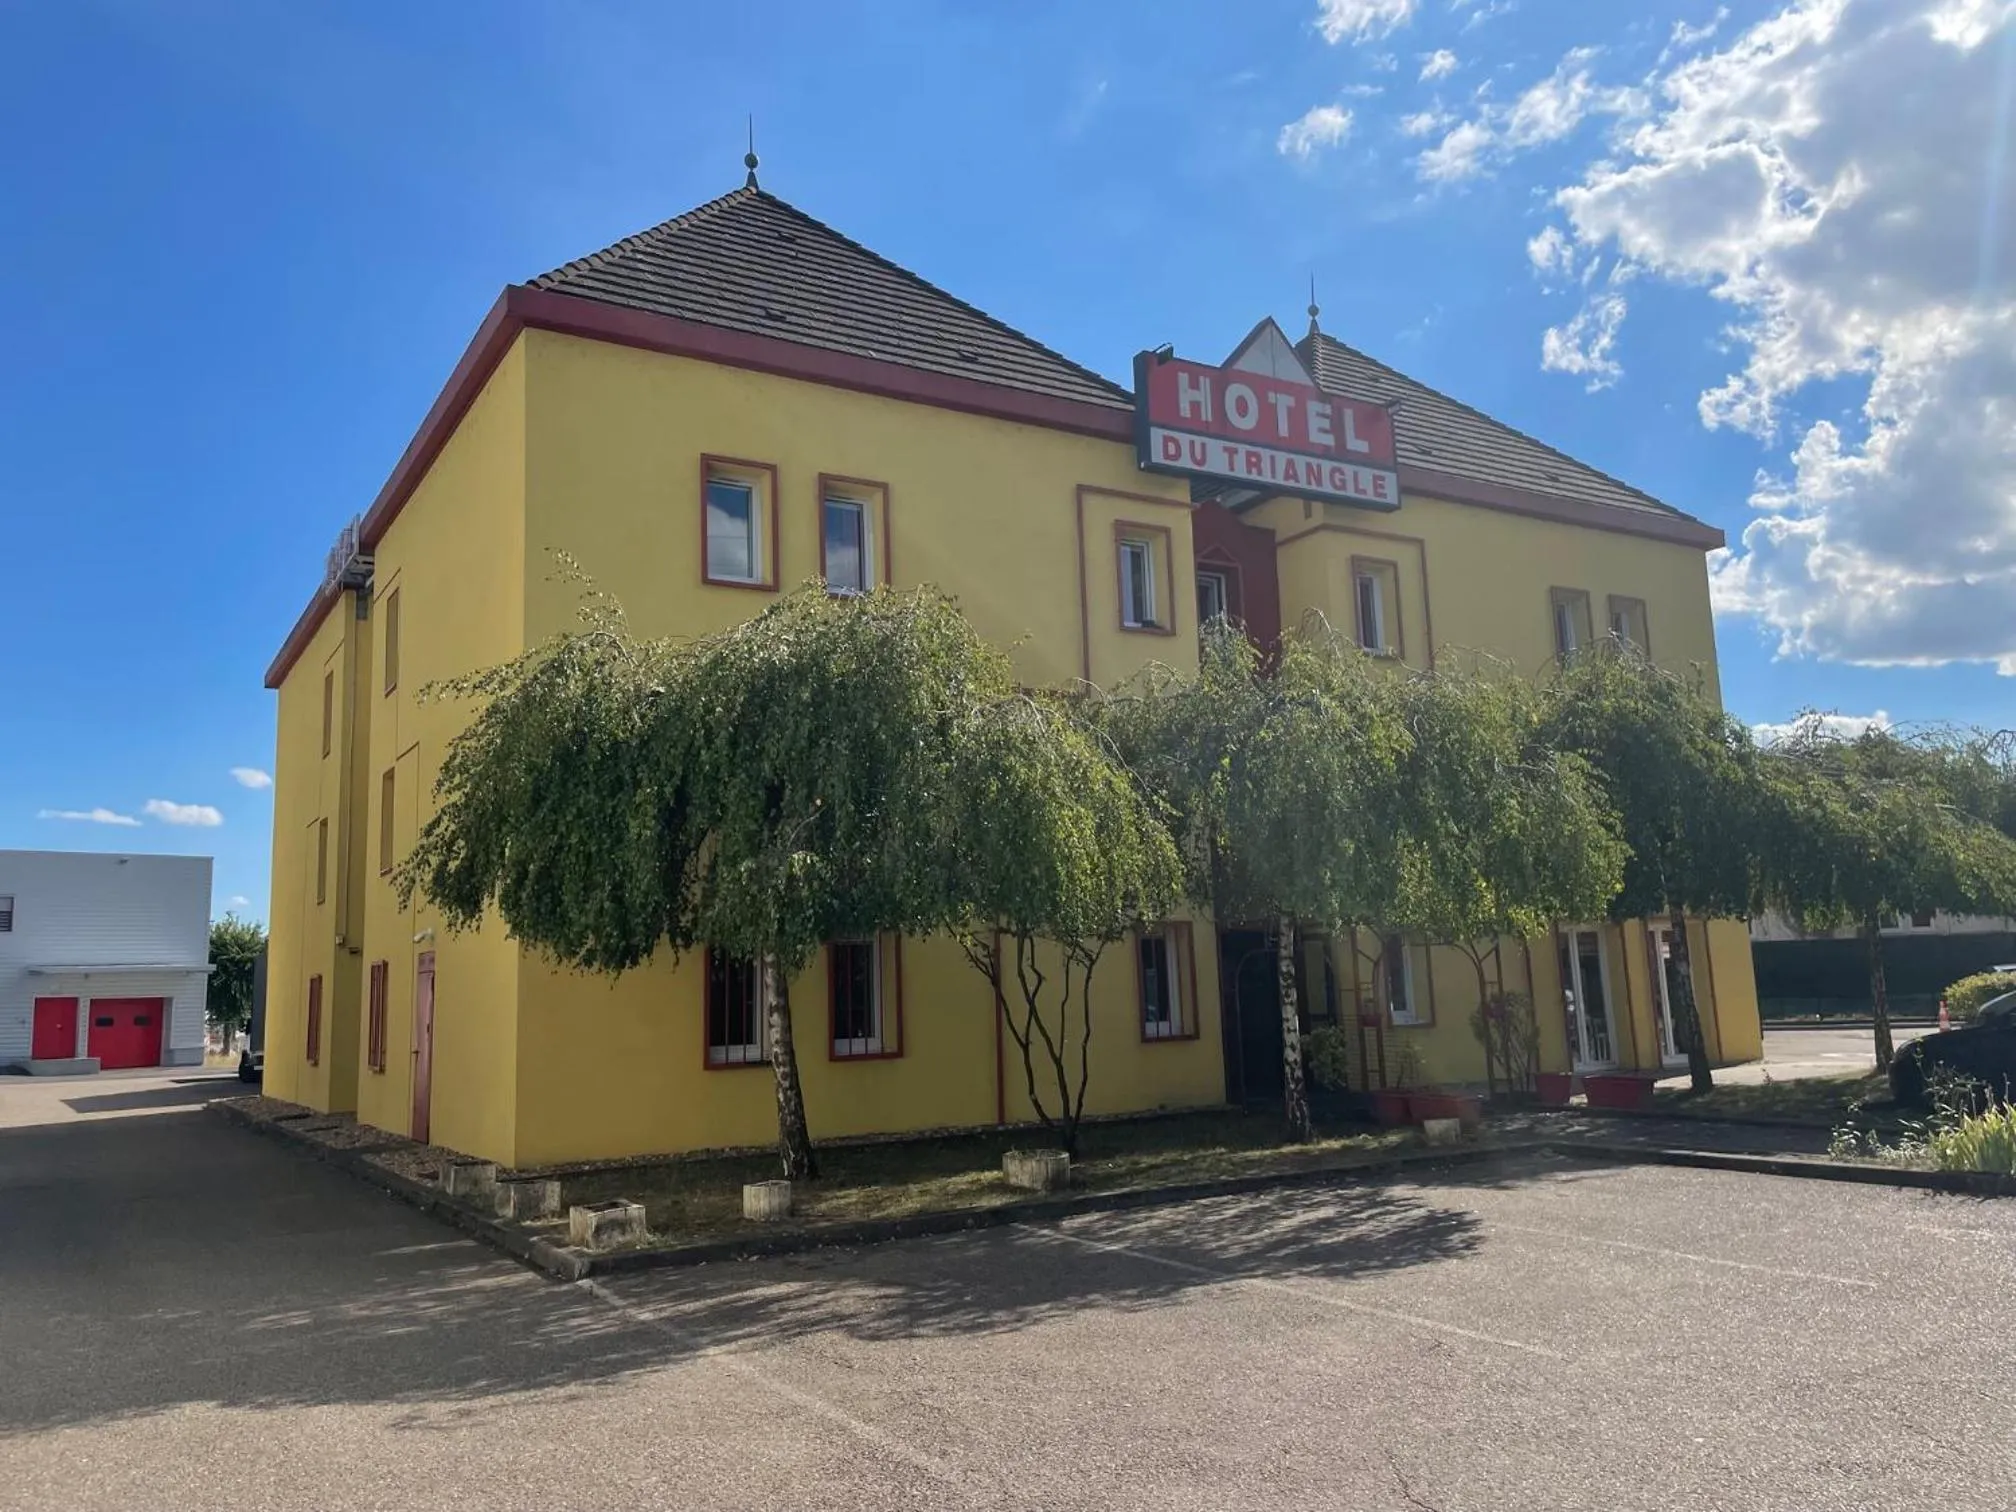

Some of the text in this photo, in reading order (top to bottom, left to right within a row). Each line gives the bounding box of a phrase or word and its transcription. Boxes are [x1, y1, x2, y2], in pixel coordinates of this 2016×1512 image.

[1178, 372, 1369, 452] HOTEL
[1162, 435, 1388, 499] DU TRIANGLE
